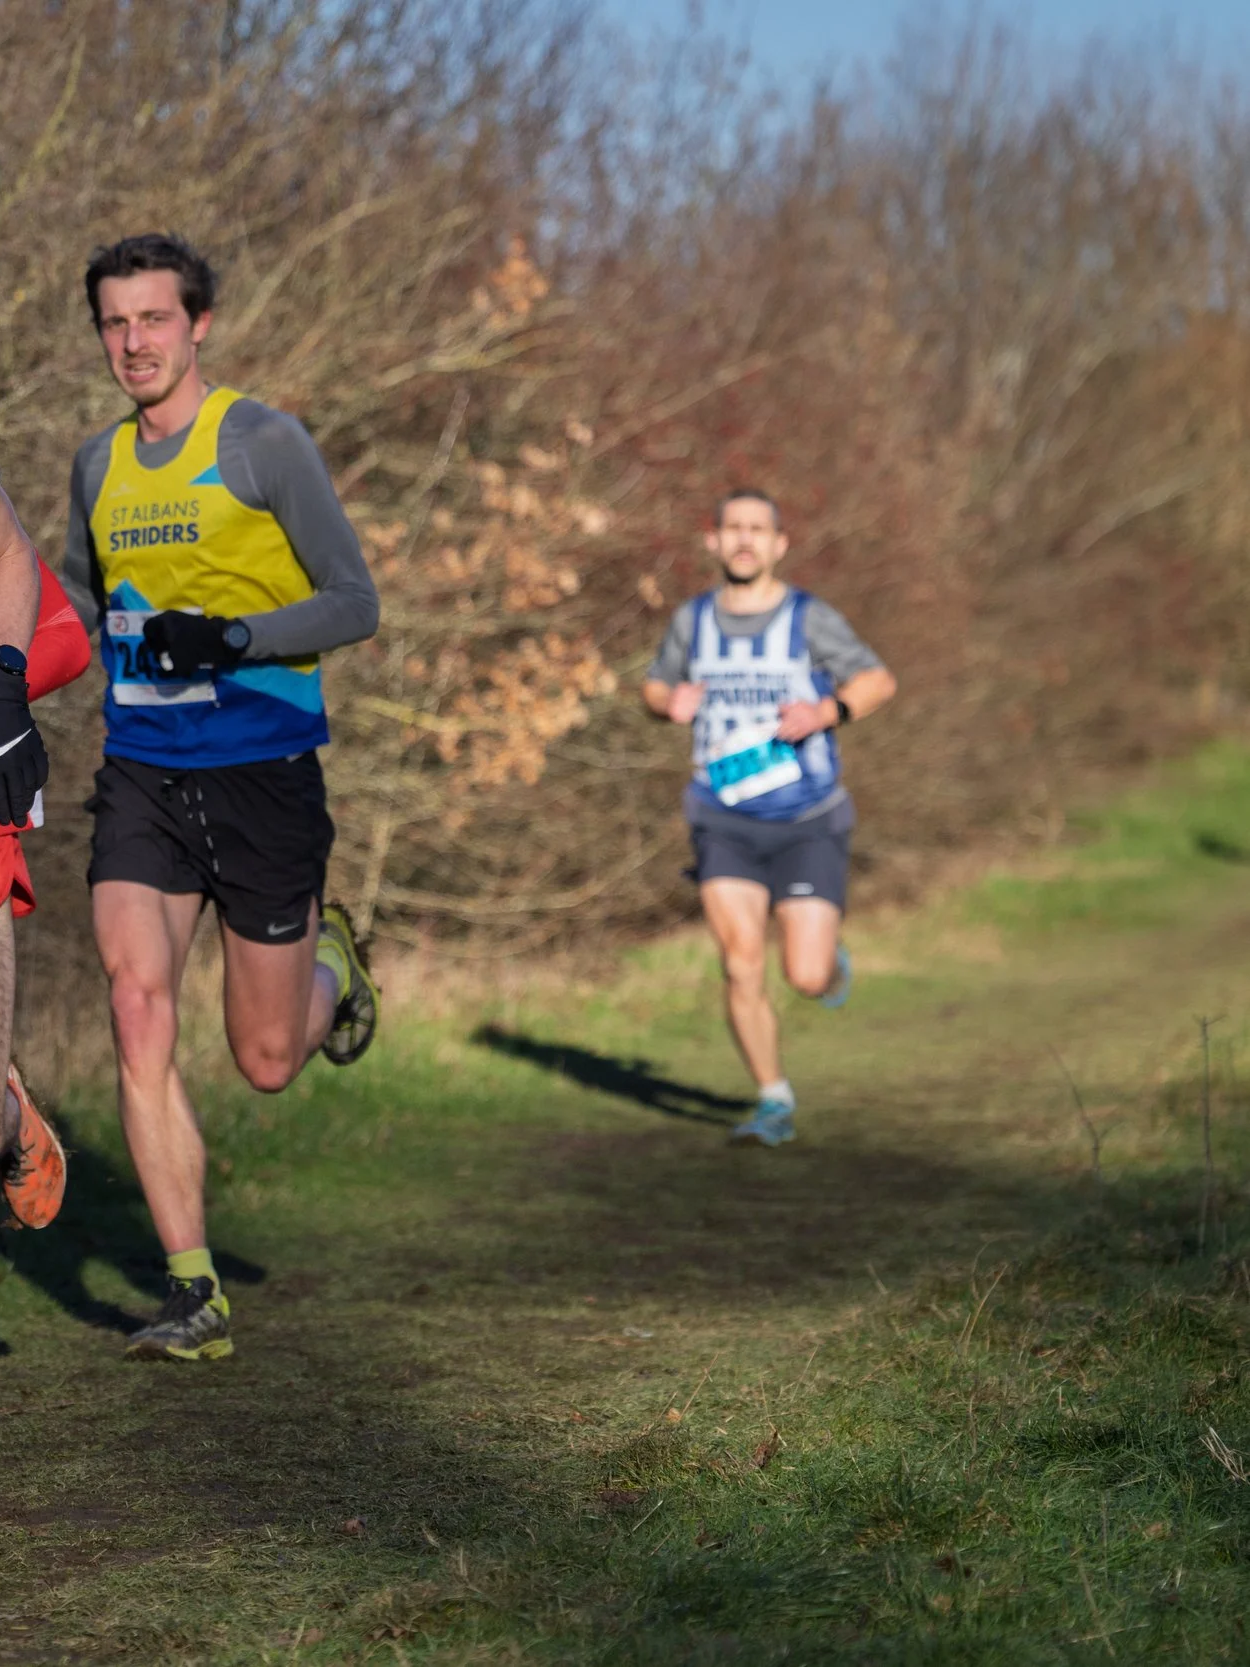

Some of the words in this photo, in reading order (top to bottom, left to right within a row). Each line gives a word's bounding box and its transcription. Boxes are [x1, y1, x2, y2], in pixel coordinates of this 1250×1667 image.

[111, 507, 127, 527] ST
[131, 498, 200, 523] ALBANS
[110, 523, 199, 552] STRIDERS
